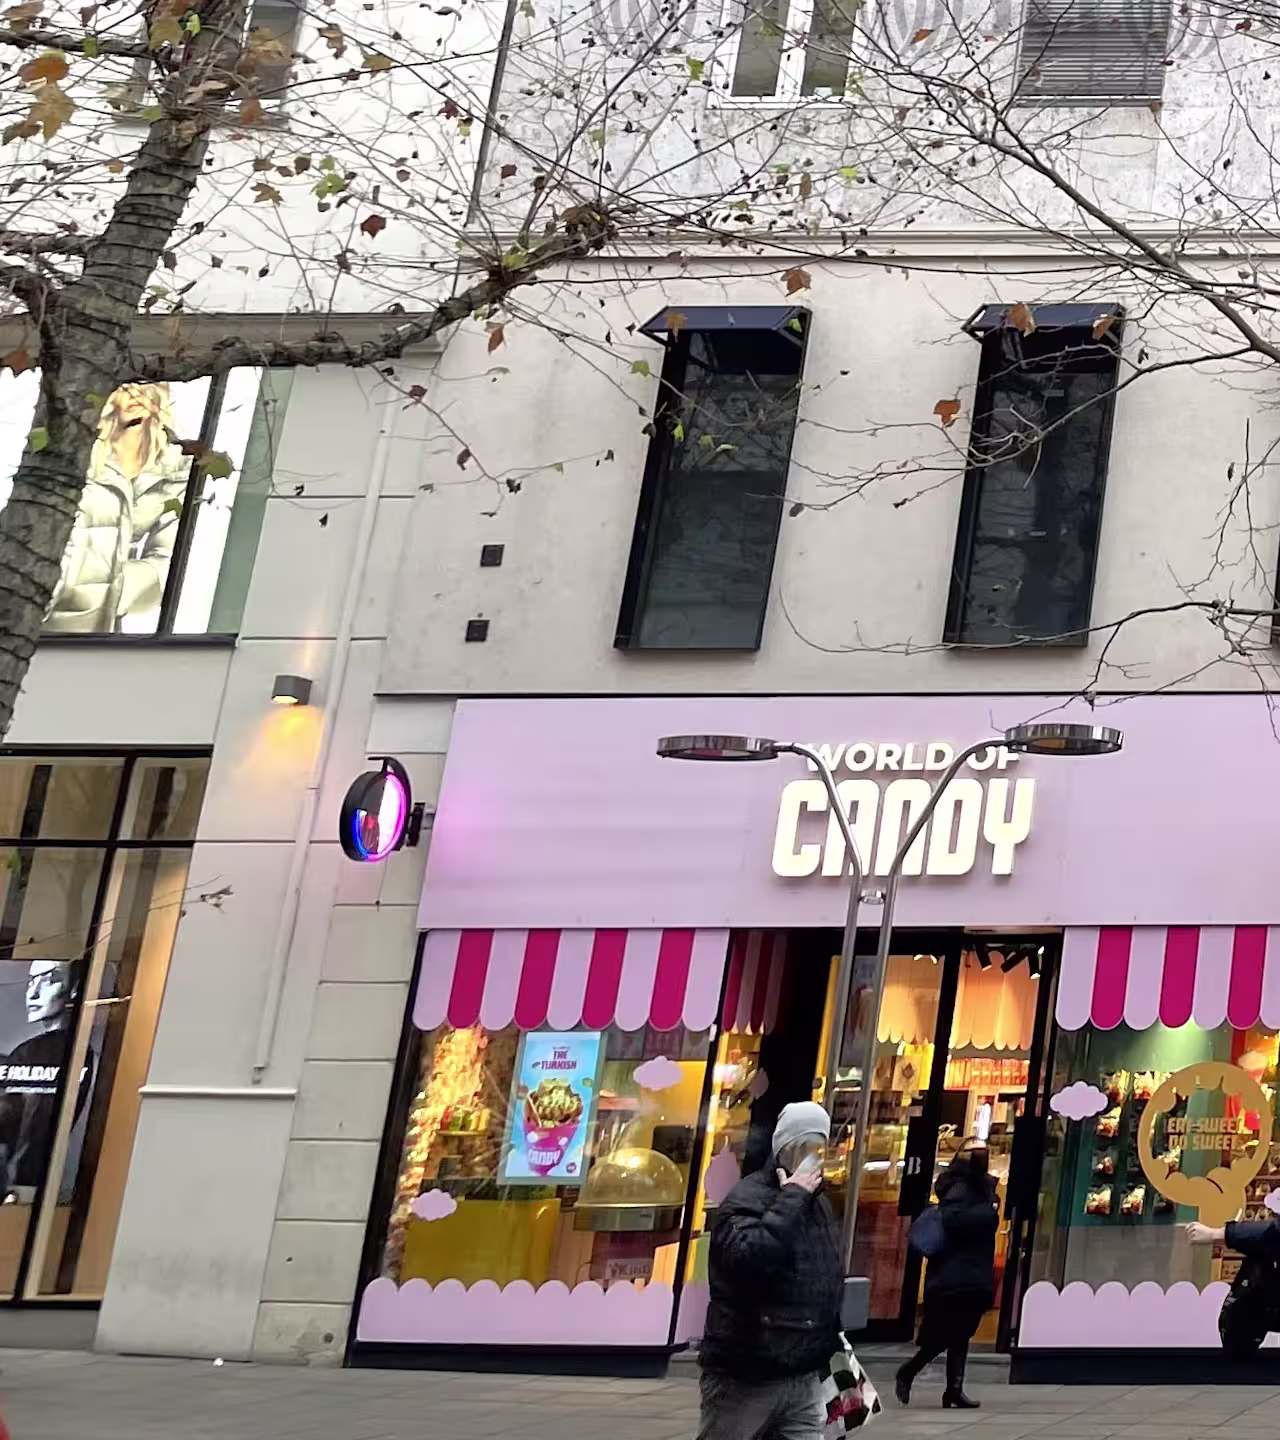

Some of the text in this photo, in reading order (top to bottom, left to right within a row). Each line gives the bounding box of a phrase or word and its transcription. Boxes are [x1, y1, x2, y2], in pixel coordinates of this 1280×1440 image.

[806, 742, 953, 772] WORLD
[771, 777, 1036, 877] CANDY
[7, 1065, 60, 1081] HOLIDAY
